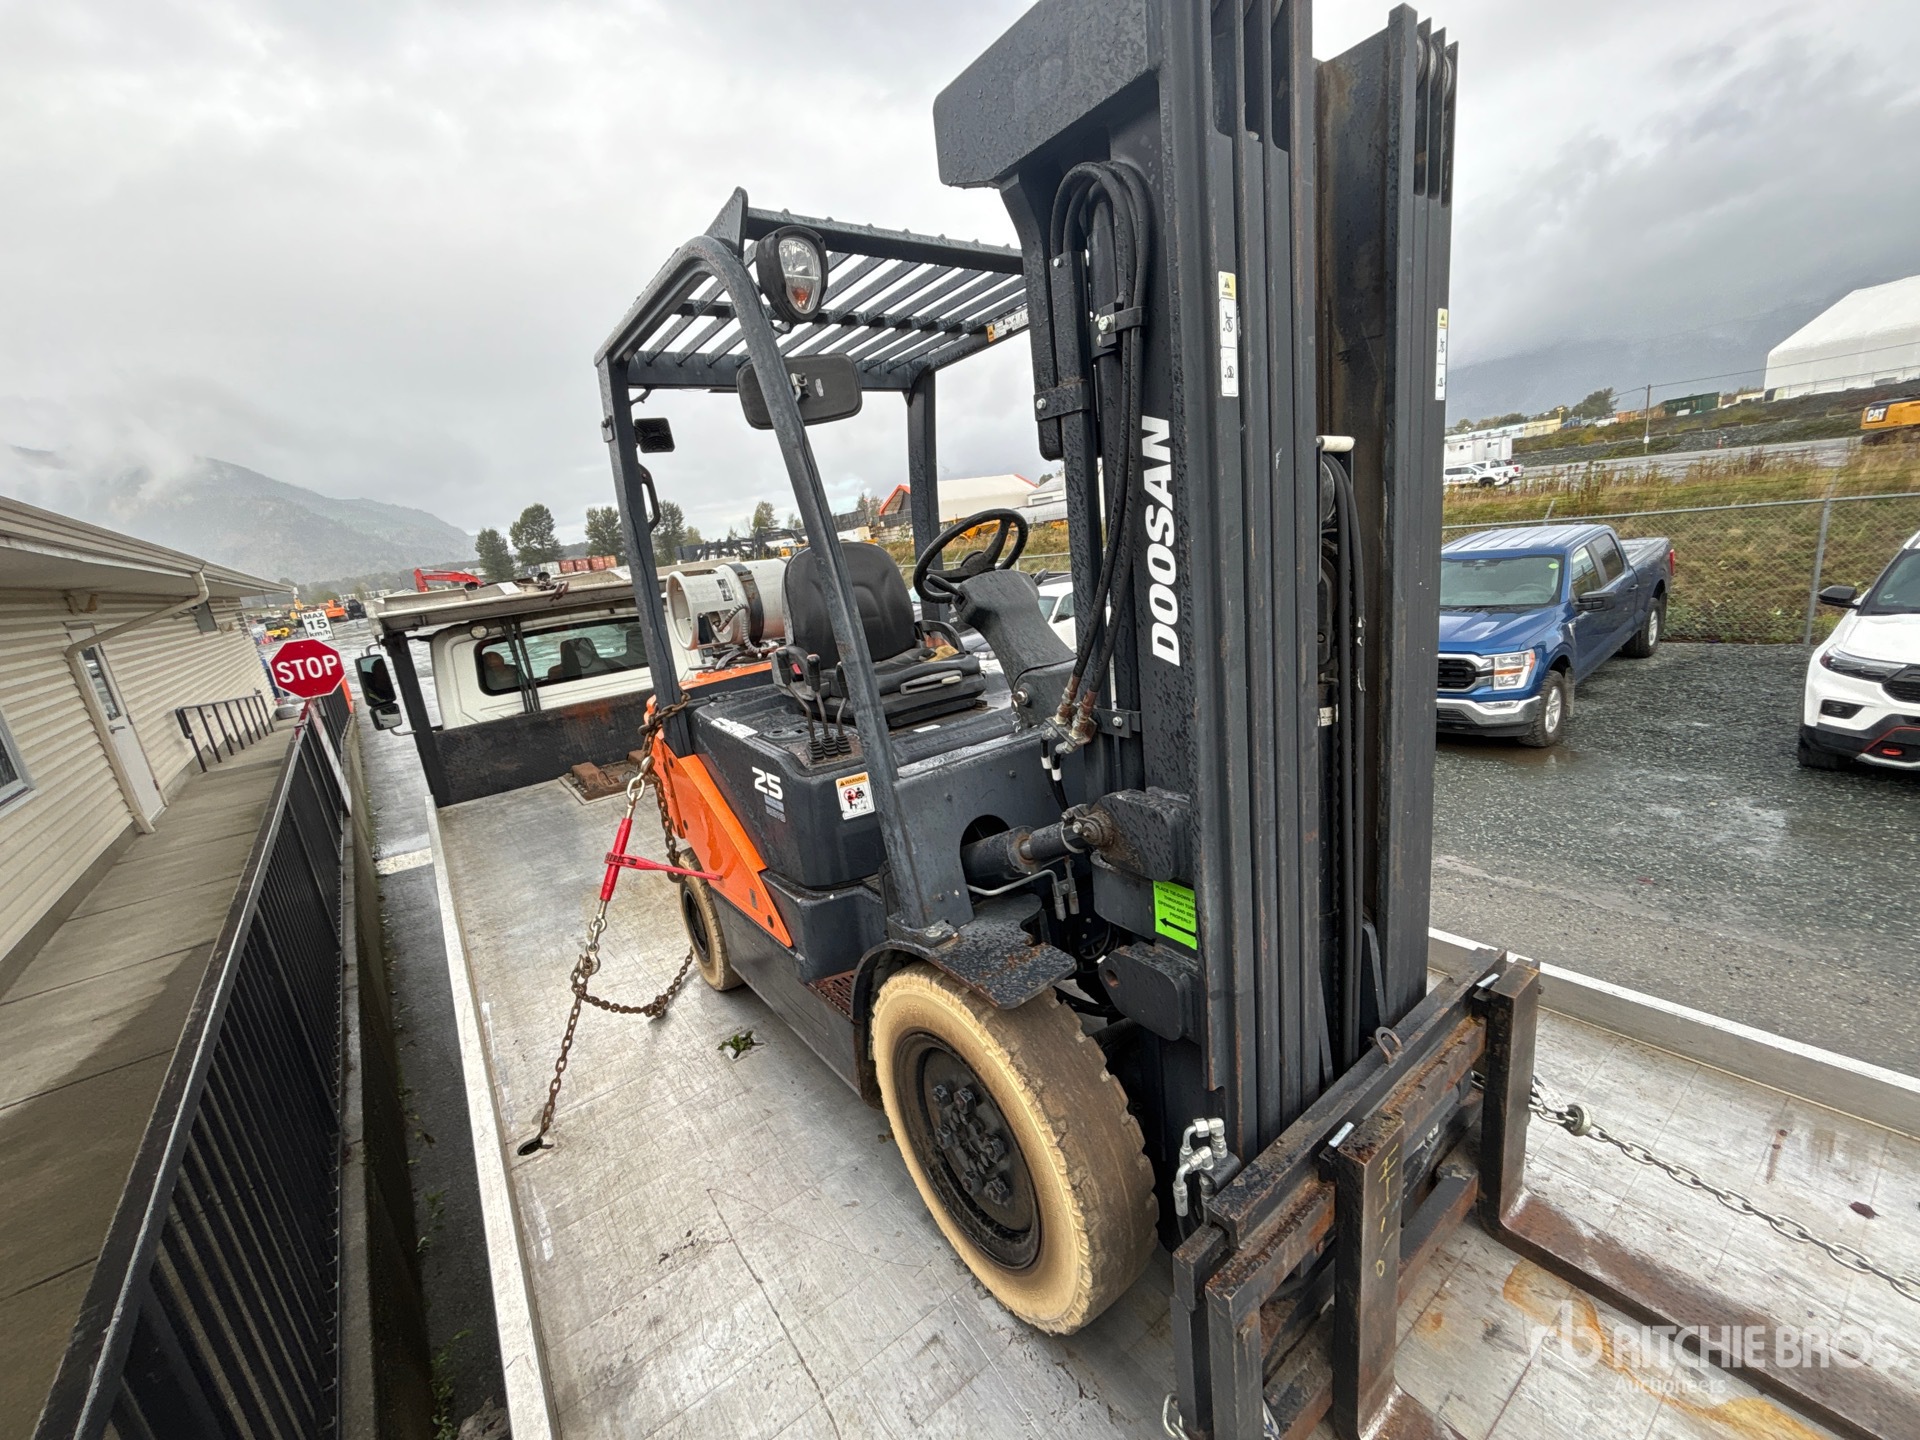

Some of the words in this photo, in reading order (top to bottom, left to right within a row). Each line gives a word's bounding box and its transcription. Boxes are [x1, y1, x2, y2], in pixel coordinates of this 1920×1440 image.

[1867, 408, 1886, 421] CAT
[1141, 415, 1180, 667] DOOSAN
[303, 612, 325, 620] MAX
[306, 619, 328, 630] 15
[309, 629, 331, 637] km/h
[276, 654, 338, 684] STOP
[751, 766, 784, 801] 25
